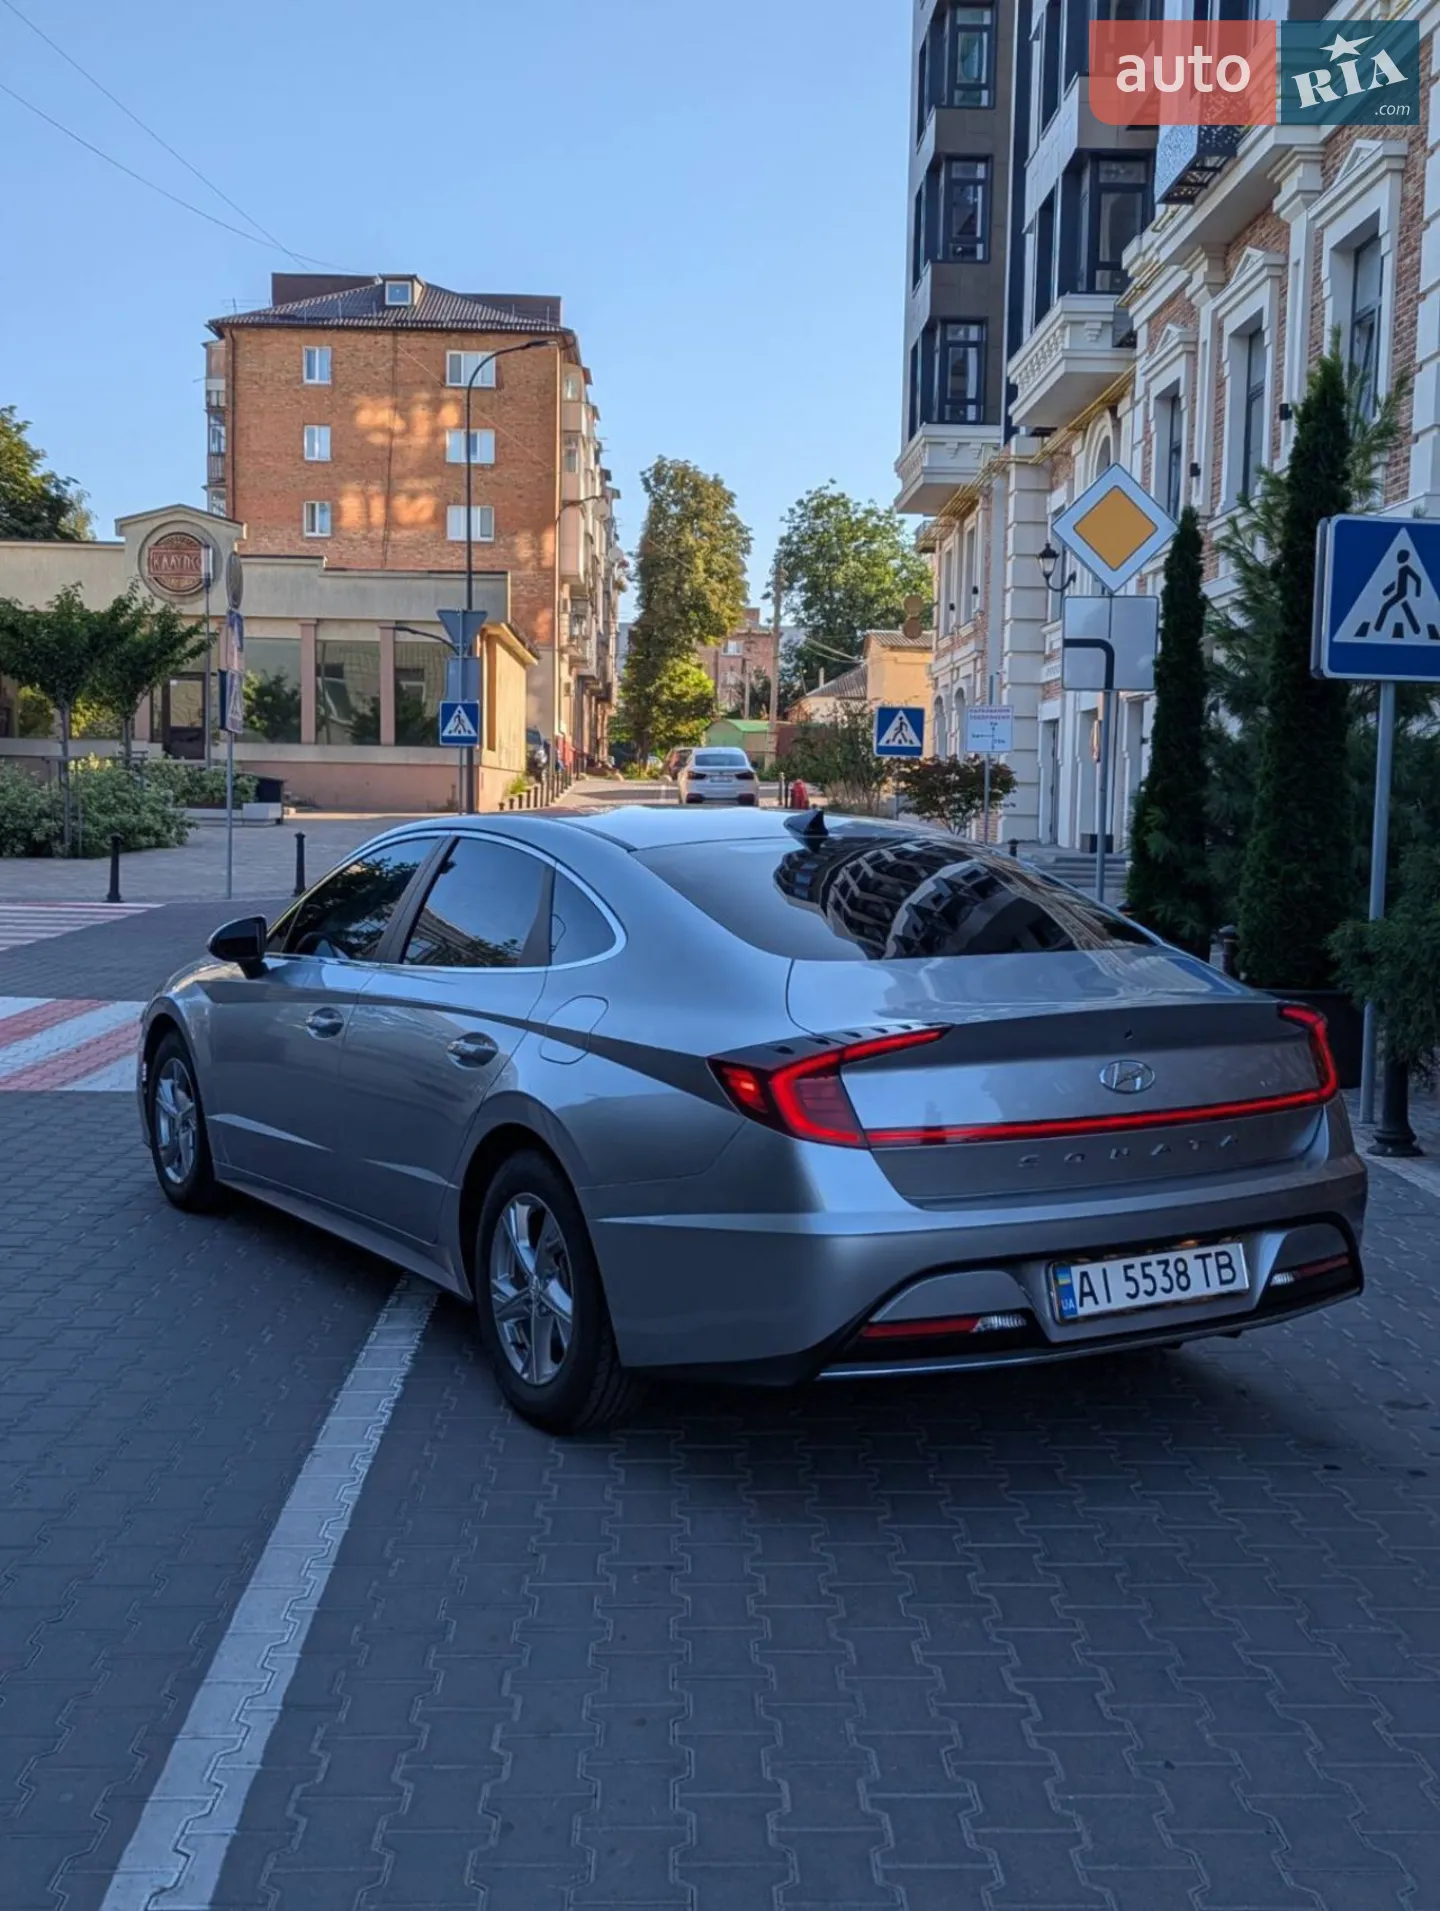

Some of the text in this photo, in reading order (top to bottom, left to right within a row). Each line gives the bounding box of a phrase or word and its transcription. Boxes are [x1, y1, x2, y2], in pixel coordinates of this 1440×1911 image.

[1078, 1250, 1237, 1308] AI 5538 TB
